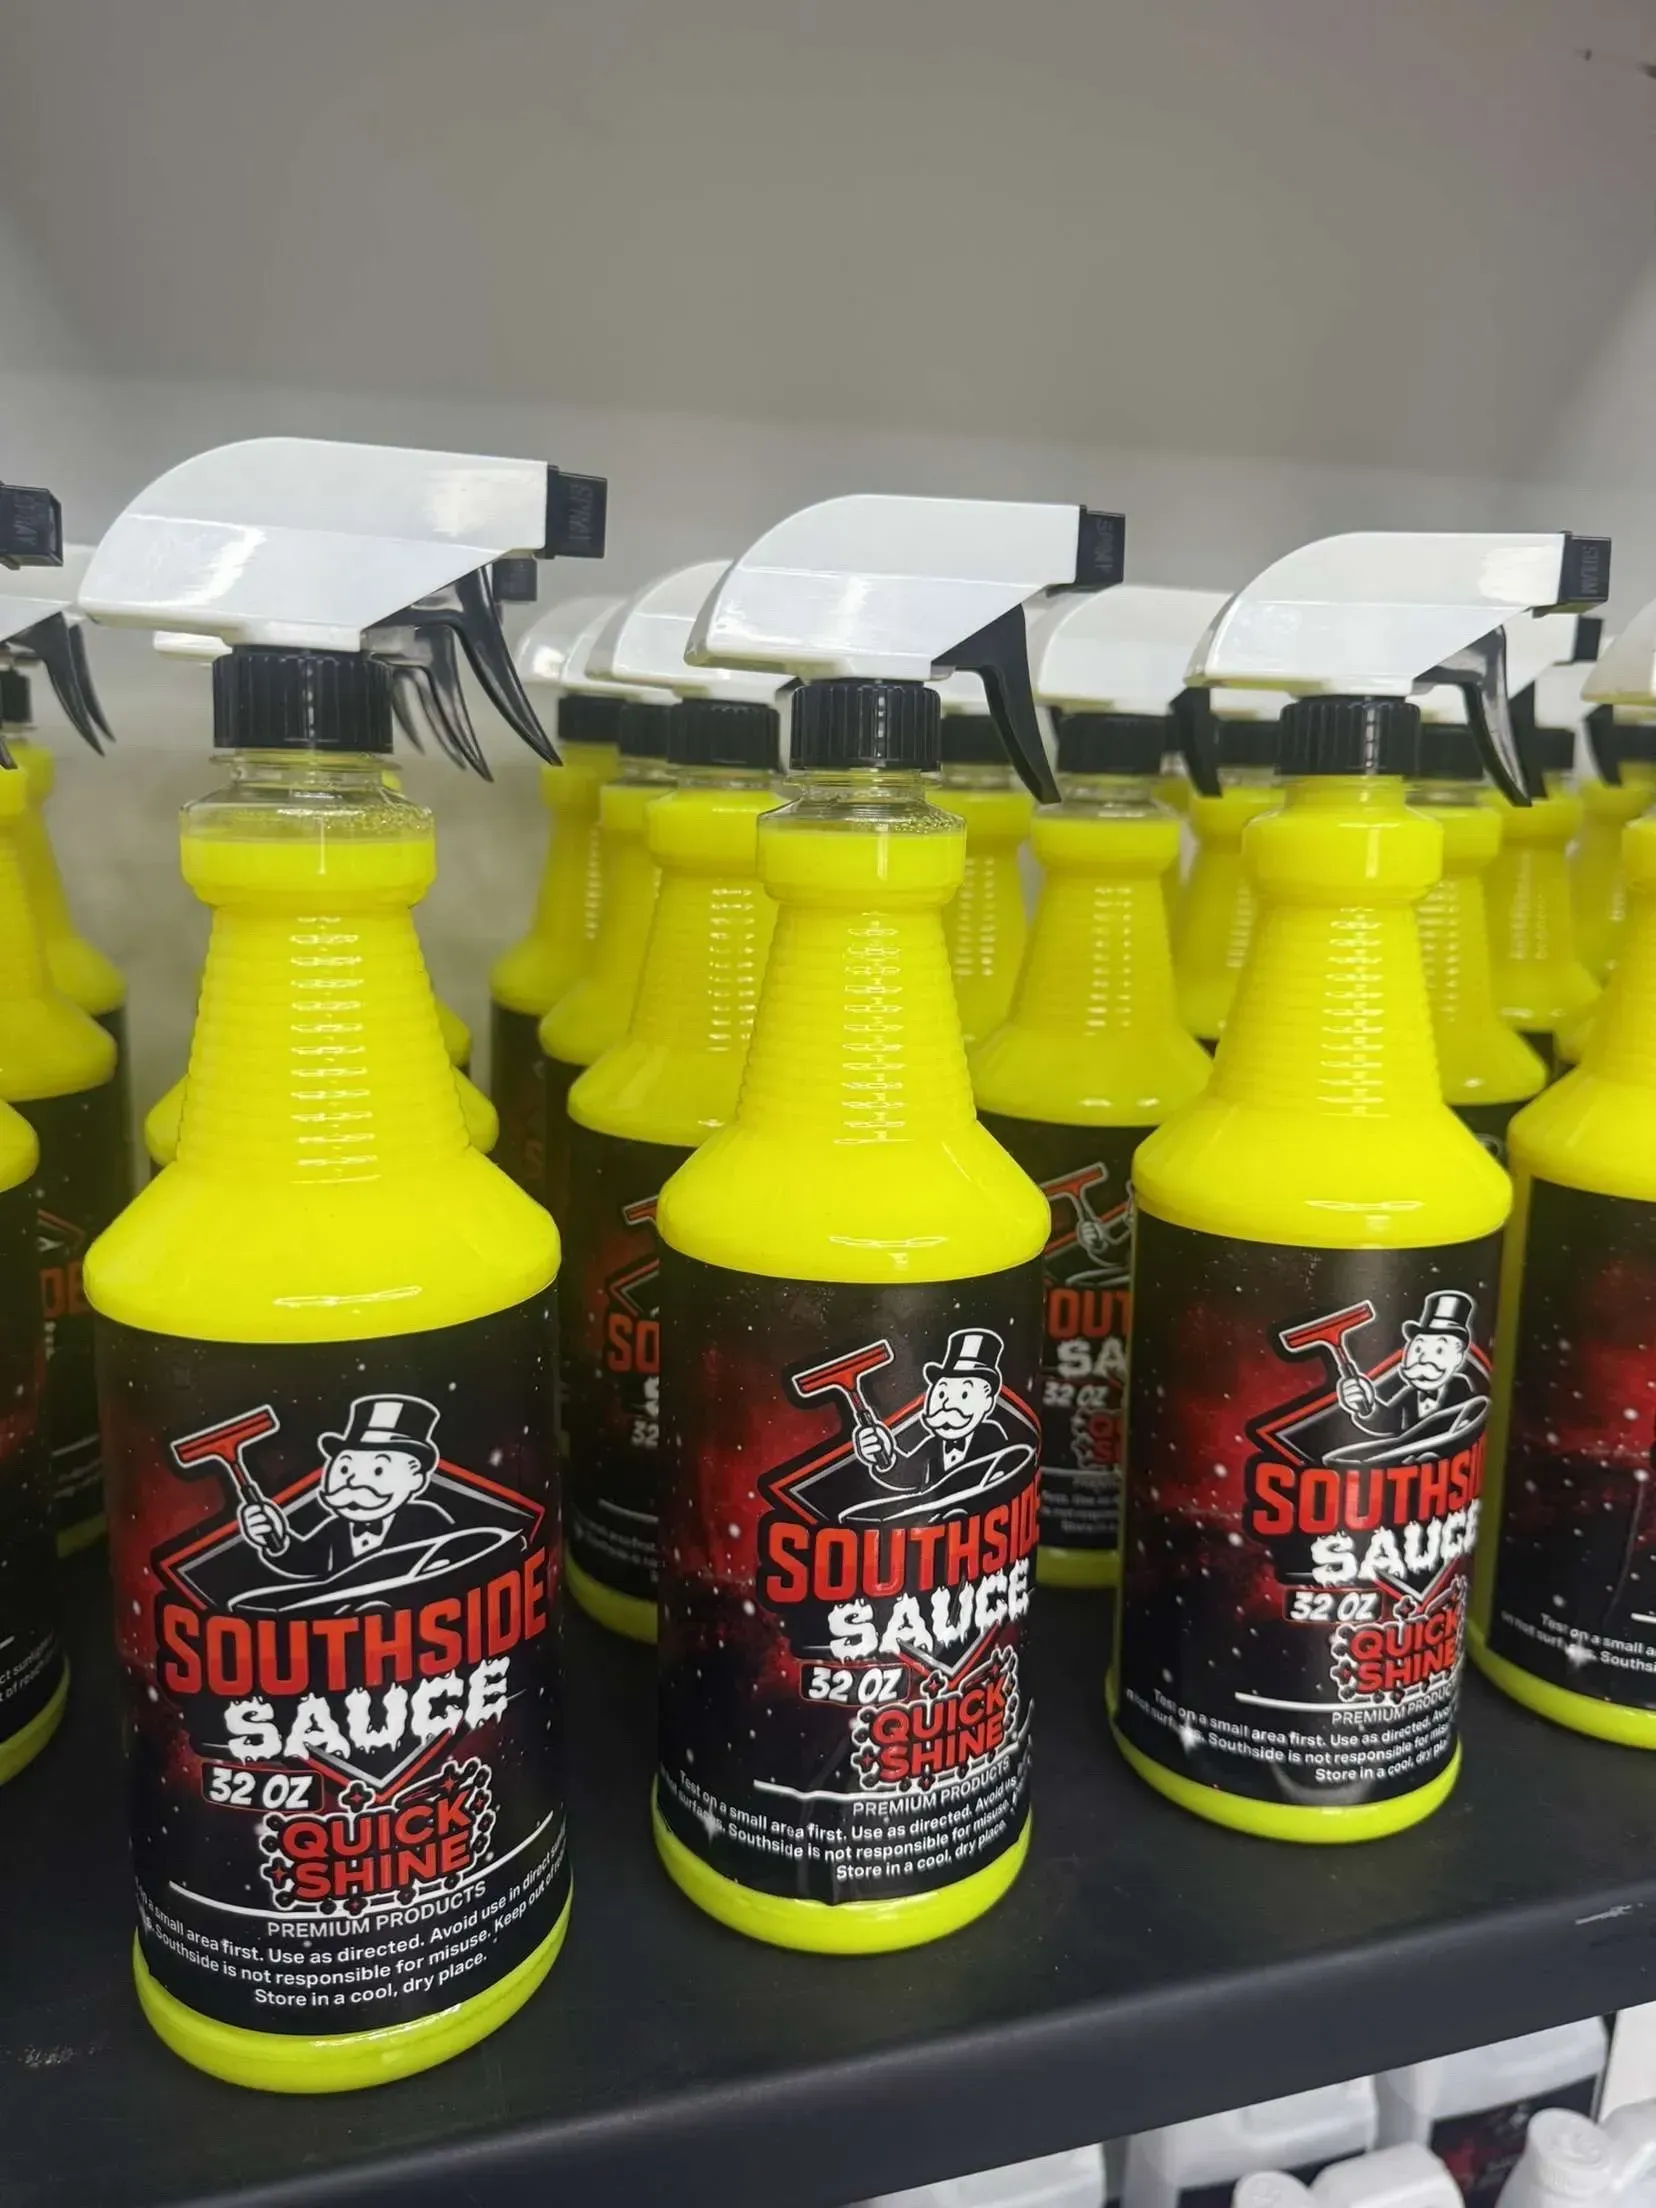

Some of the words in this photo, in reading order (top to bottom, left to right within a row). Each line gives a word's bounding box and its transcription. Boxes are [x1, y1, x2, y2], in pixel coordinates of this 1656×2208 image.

[1253, 1431, 1487, 1535] SOUTHSI
[163, 1546, 546, 1696] SOUTHSIDE
[828, 1557, 1030, 1663] SAUCE
[1290, 1592, 1333, 1621] 32
[1336, 1592, 1378, 1621] OZ
[1569, 1628, 1589, 1641] on
[1590, 1635, 1600, 1644] a
[1602, 1637, 1643, 1654] small
[1600, 1650, 1656, 1673] Southsi
[223, 1656, 511, 1765] SAUCE
[808, 1667, 853, 1702] 32
[857, 1668, 903, 1704] OZ
[870, 1676, 1007, 1744] QUICK
[1332, 1708, 1406, 1725] PREMIUM
[1408, 1687, 1452, 1714] PRODUC
[879, 1716, 1005, 1782] SHINE
[1178, 1708, 1196, 1722] on
[1199, 1714, 1208, 1725] a
[1210, 1717, 1249, 1738] small
[1252, 1728, 1286, 1745] area
[1289, 1731, 1326, 1747] first.
[1331, 1734, 1358, 1747] Use
[1361, 1734, 1377, 1745] as
[1381, 1718, 1431, 1743] directed.
[1208, 1731, 1284, 1761] Southside
[1288, 1749, 1301, 1764] is
[1305, 1751, 1331, 1765] not
[1335, 1740, 1412, 1765] responsible
[1414, 1734, 1428, 1748] for
[207, 1767, 255, 1806] 32
[261, 1775, 315, 1810] OZ
[853, 1794, 936, 1816] PREMIUM
[940, 1756, 1010, 1805] PRODUCTS
[1315, 1768, 1355, 1782] Store
[1360, 1766, 1373, 1779] in
[1376, 1768, 1385, 1777] a
[1416, 1750, 1432, 1765] dry
[282, 1790, 472, 1859] QUICK
[680, 1769, 700, 1798] Test
[702, 1791, 718, 1809] on
[720, 1801, 727, 1814] a
[729, 1806, 767, 1830] small
[771, 1821, 804, 1840] area
[807, 1823, 847, 1842] first.
[851, 1825, 883, 1840] Use
[887, 1825, 906, 1838] as
[909, 1805, 972, 1834] directed.
[975, 1783, 1005, 1811] Avoid
[295, 1831, 470, 1899] SHINE
[728, 1822, 804, 1859] Southside
[808, 1843, 821, 1858] is
[824, 1846, 852, 1863] not
[856, 1833, 949, 1862] responsible
[952, 1824, 972, 1842] for
[836, 1864, 881, 1881] Store
[885, 1862, 900, 1878] in
[904, 1862, 913, 1873] a
[917, 1851, 952, 1870] cool,
[955, 1840, 976, 1859] dry
[155, 1906, 184, 1936] small
[186, 1928, 219, 1951] area
[221, 1938, 264, 1962] first.
[268, 1948, 305, 1964] Use
[310, 1951, 332, 1964] as
[337, 1934, 425, 1962] directed.
[430, 1911, 478, 1944] Avoid
[481, 1897, 507, 1920] use
[509, 1885, 520, 1900] in
[522, 1852, 551, 1889] direct
[155, 1924, 219, 1972] Southside
[223, 1961, 237, 1977] is
[241, 1968, 271, 1984] not
[276, 1964, 391, 1988] responsible
[395, 1956, 424, 1974] for
[429, 1931, 491, 1965] misuse.
[494, 1902, 526, 1932] Keep
[528, 1883, 545, 1904] out
[268, 1917, 370, 1937] PREMIUM
[376, 1881, 486, 1930] PRODUCTS
[255, 1988, 307, 2006] Store
[311, 1992, 329, 2006] in
[334, 1994, 345, 2004] a
[350, 1984, 398, 2003] cool,
[402, 1975, 433, 1994] dry
[438, 1956, 487, 1985] place.
